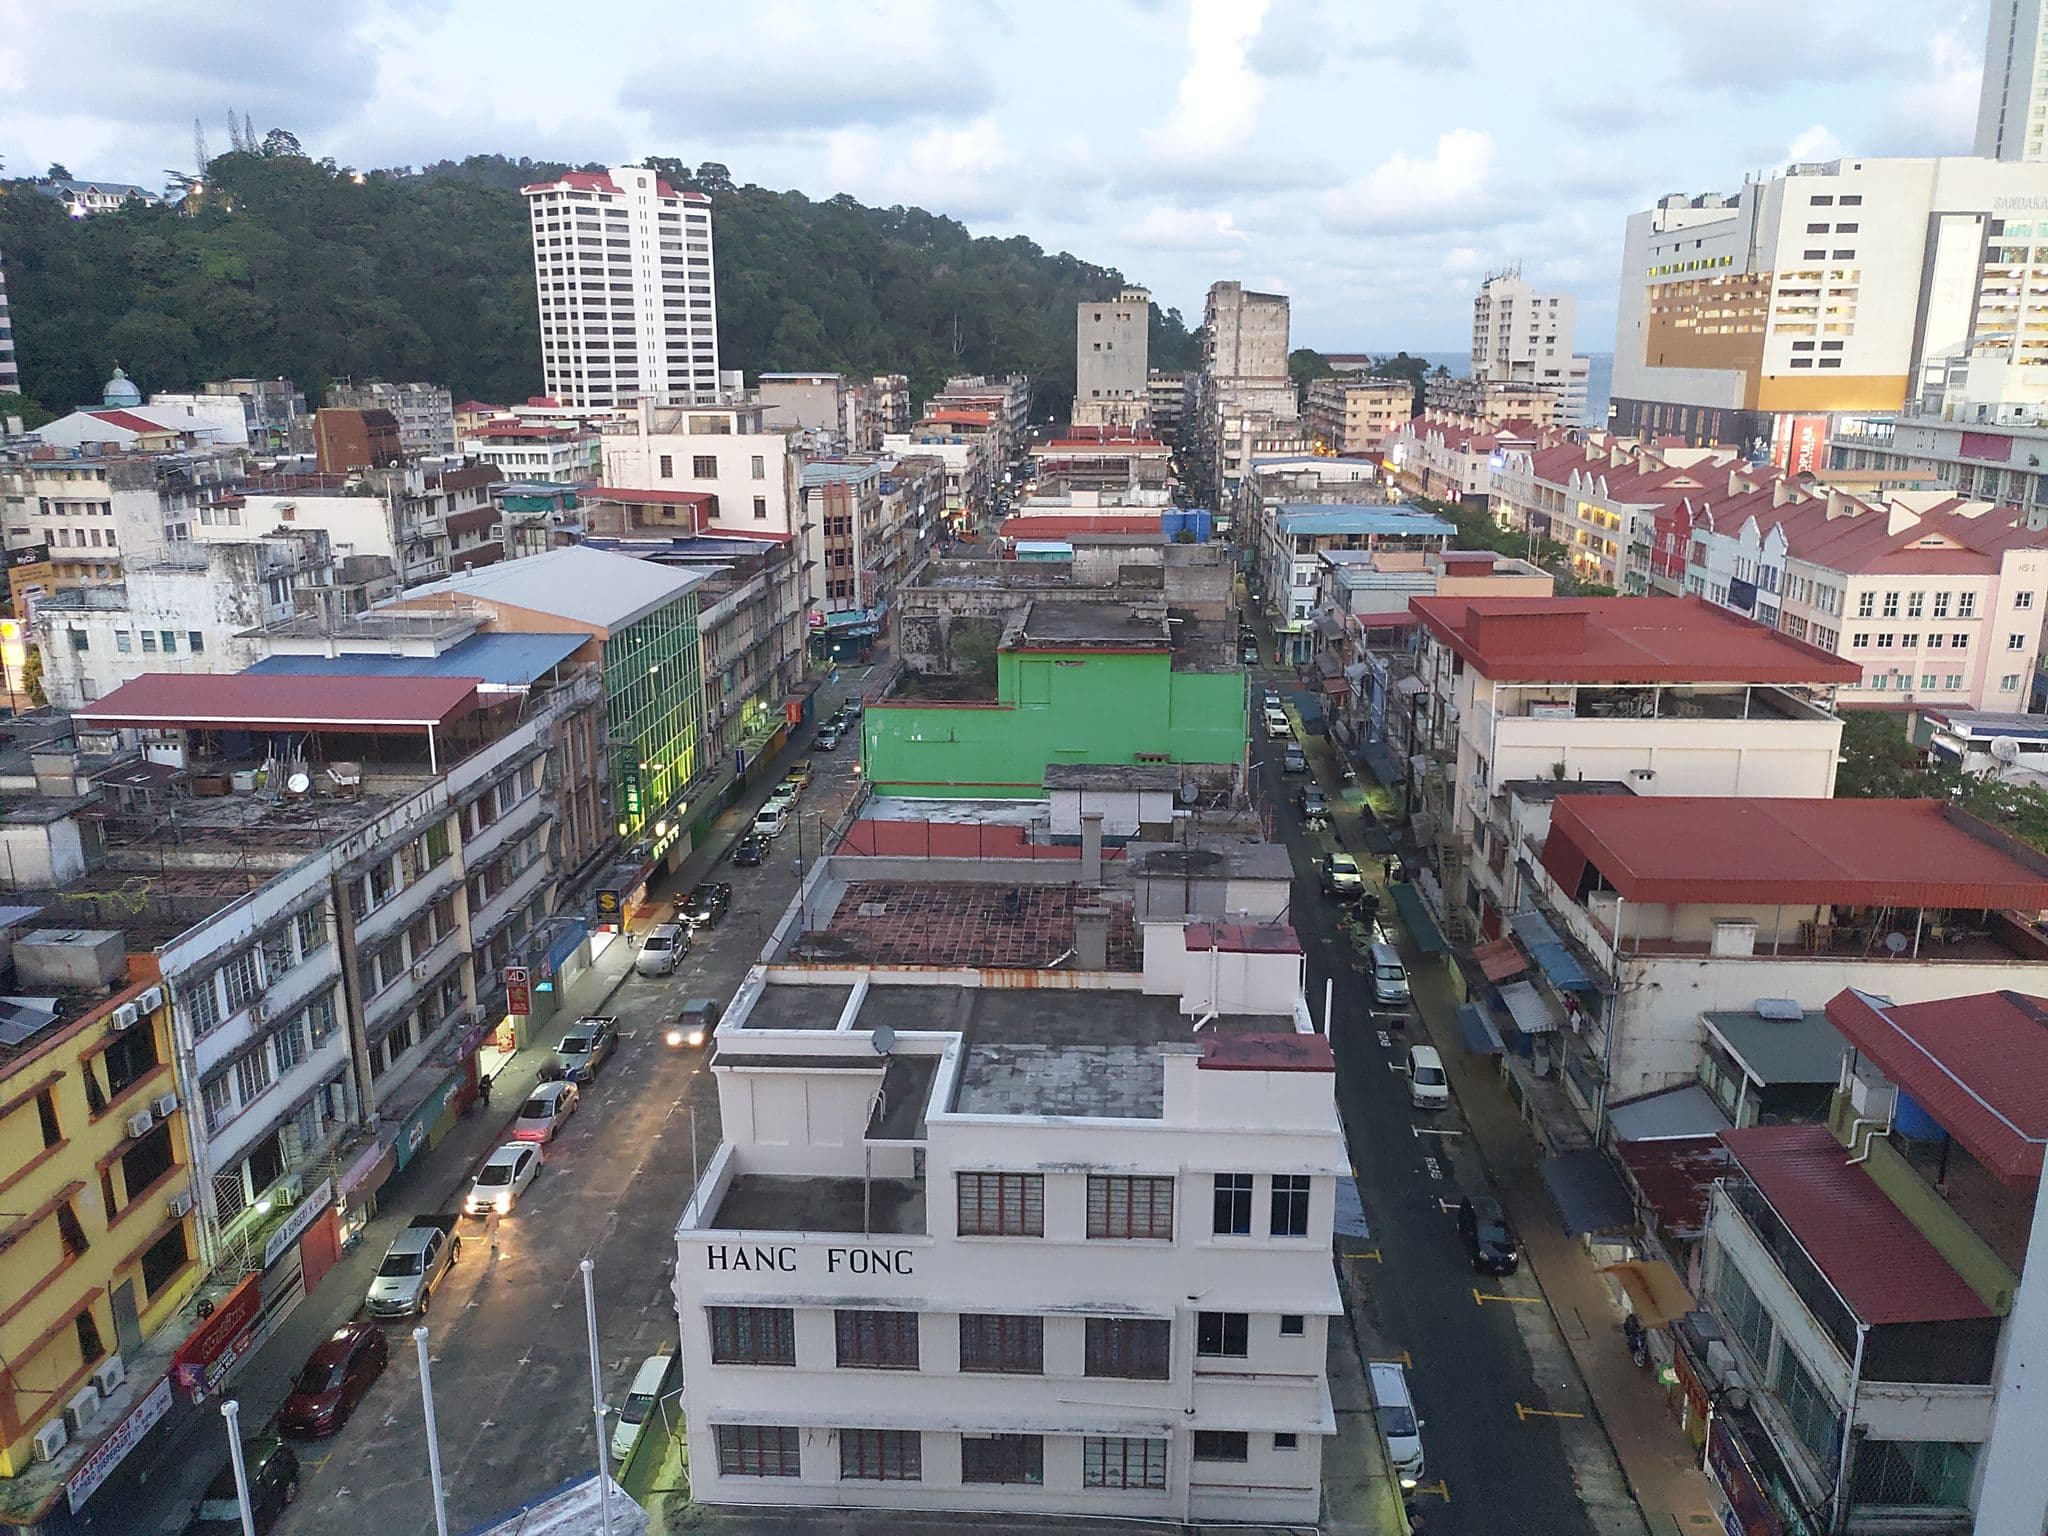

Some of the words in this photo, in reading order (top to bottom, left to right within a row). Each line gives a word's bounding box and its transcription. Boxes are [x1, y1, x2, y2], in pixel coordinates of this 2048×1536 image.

[1797, 425, 1813, 473] OPULAR
[508, 970, 526, 982] 4D
[70, 1422, 131, 1490] FARMASI
